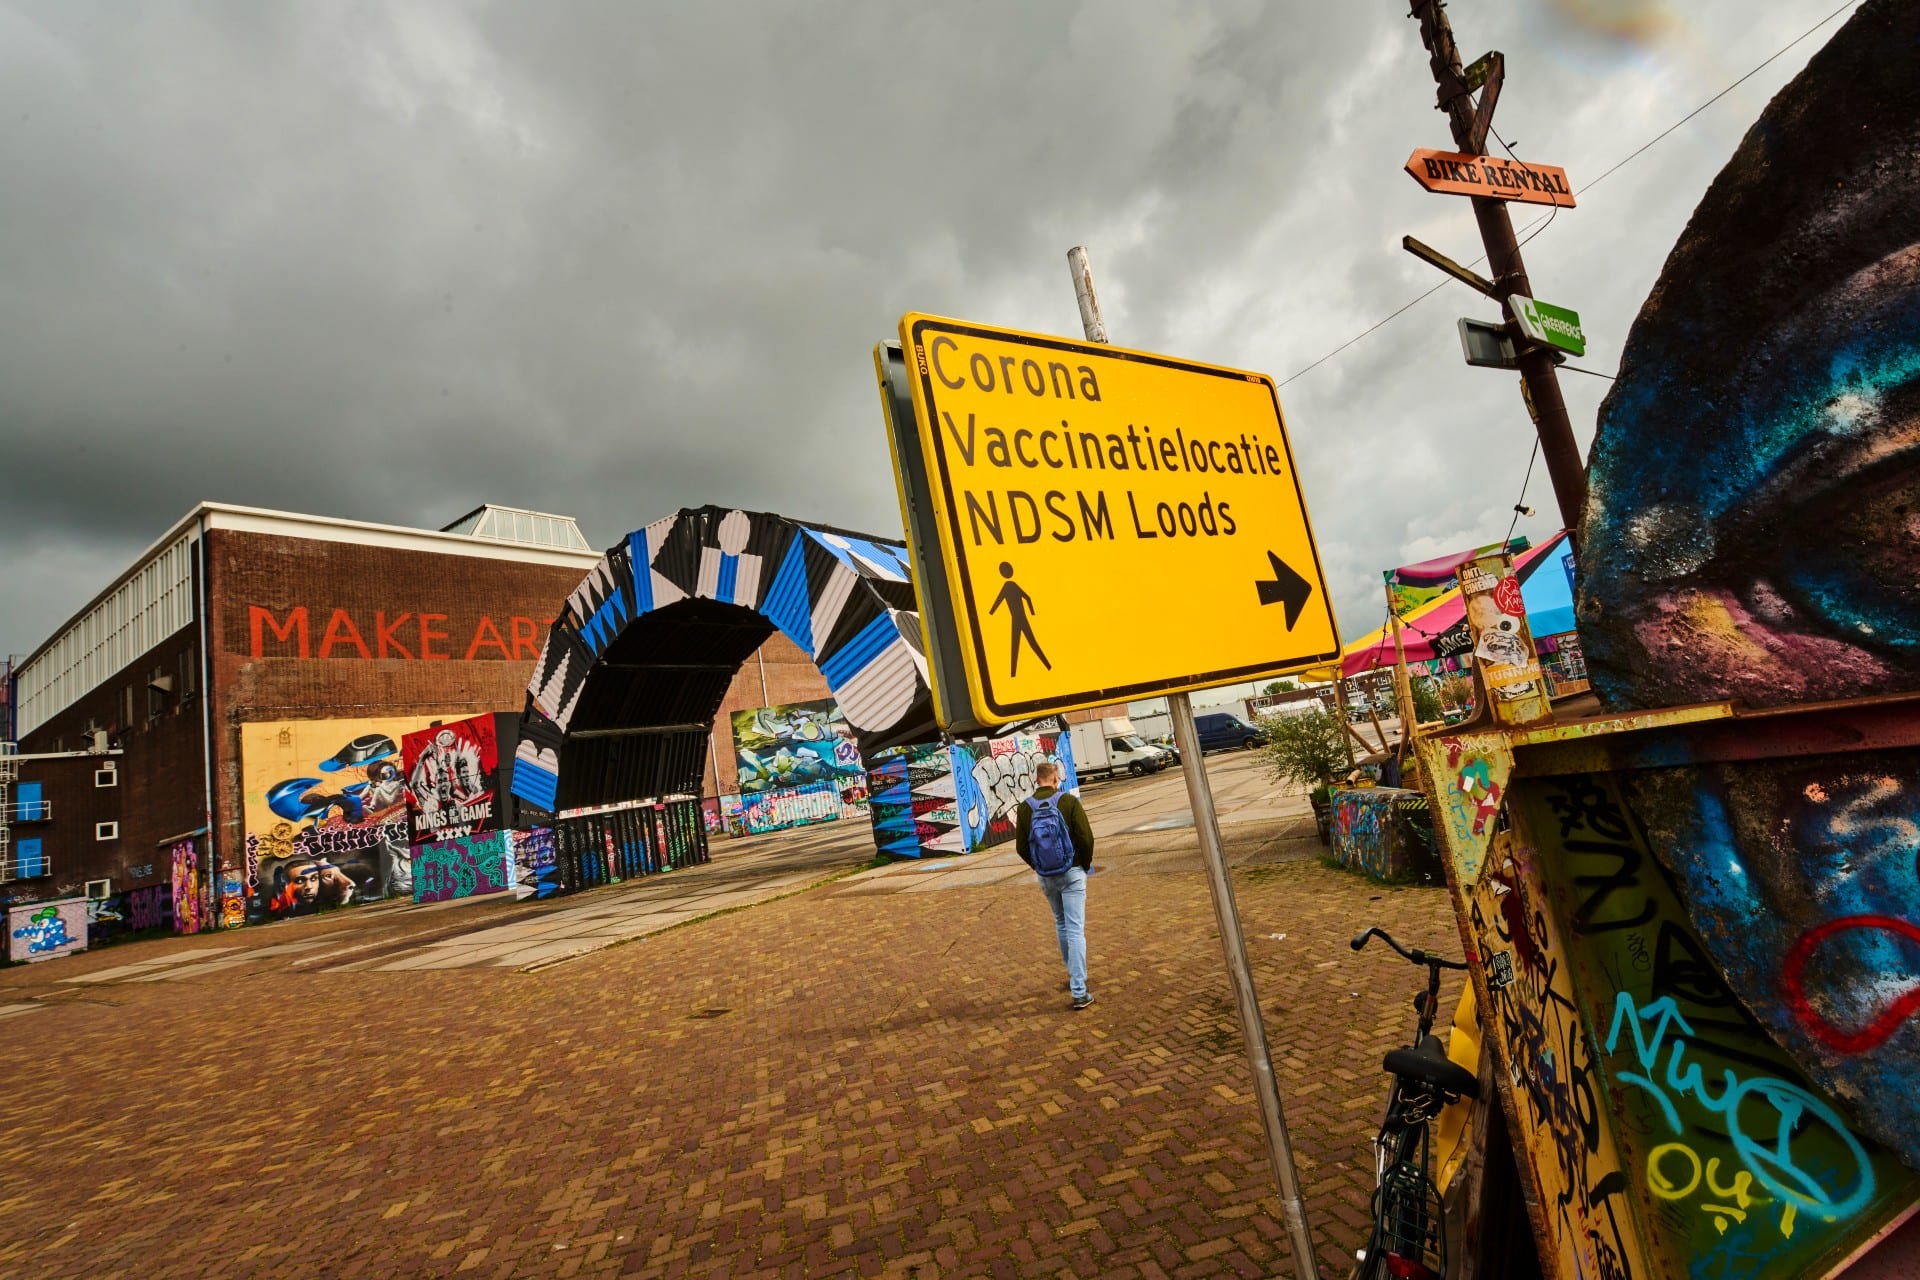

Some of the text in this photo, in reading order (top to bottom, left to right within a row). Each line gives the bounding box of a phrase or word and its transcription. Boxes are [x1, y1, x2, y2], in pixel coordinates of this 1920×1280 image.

[1422, 158, 1569, 195] BIKE RENTAL
[915, 344, 928, 376] BUKO
[931, 336, 1102, 402] Corona
[942, 411, 1283, 477] Vaccinatielocatie
[963, 490, 1237, 546] NDSM Loods
[249, 605, 450, 660] MAKE
[1437, 631, 1473, 657] JAMES
[415, 802, 493, 831] KINGS OF THE GAME
[436, 825, 472, 842] XXXV
